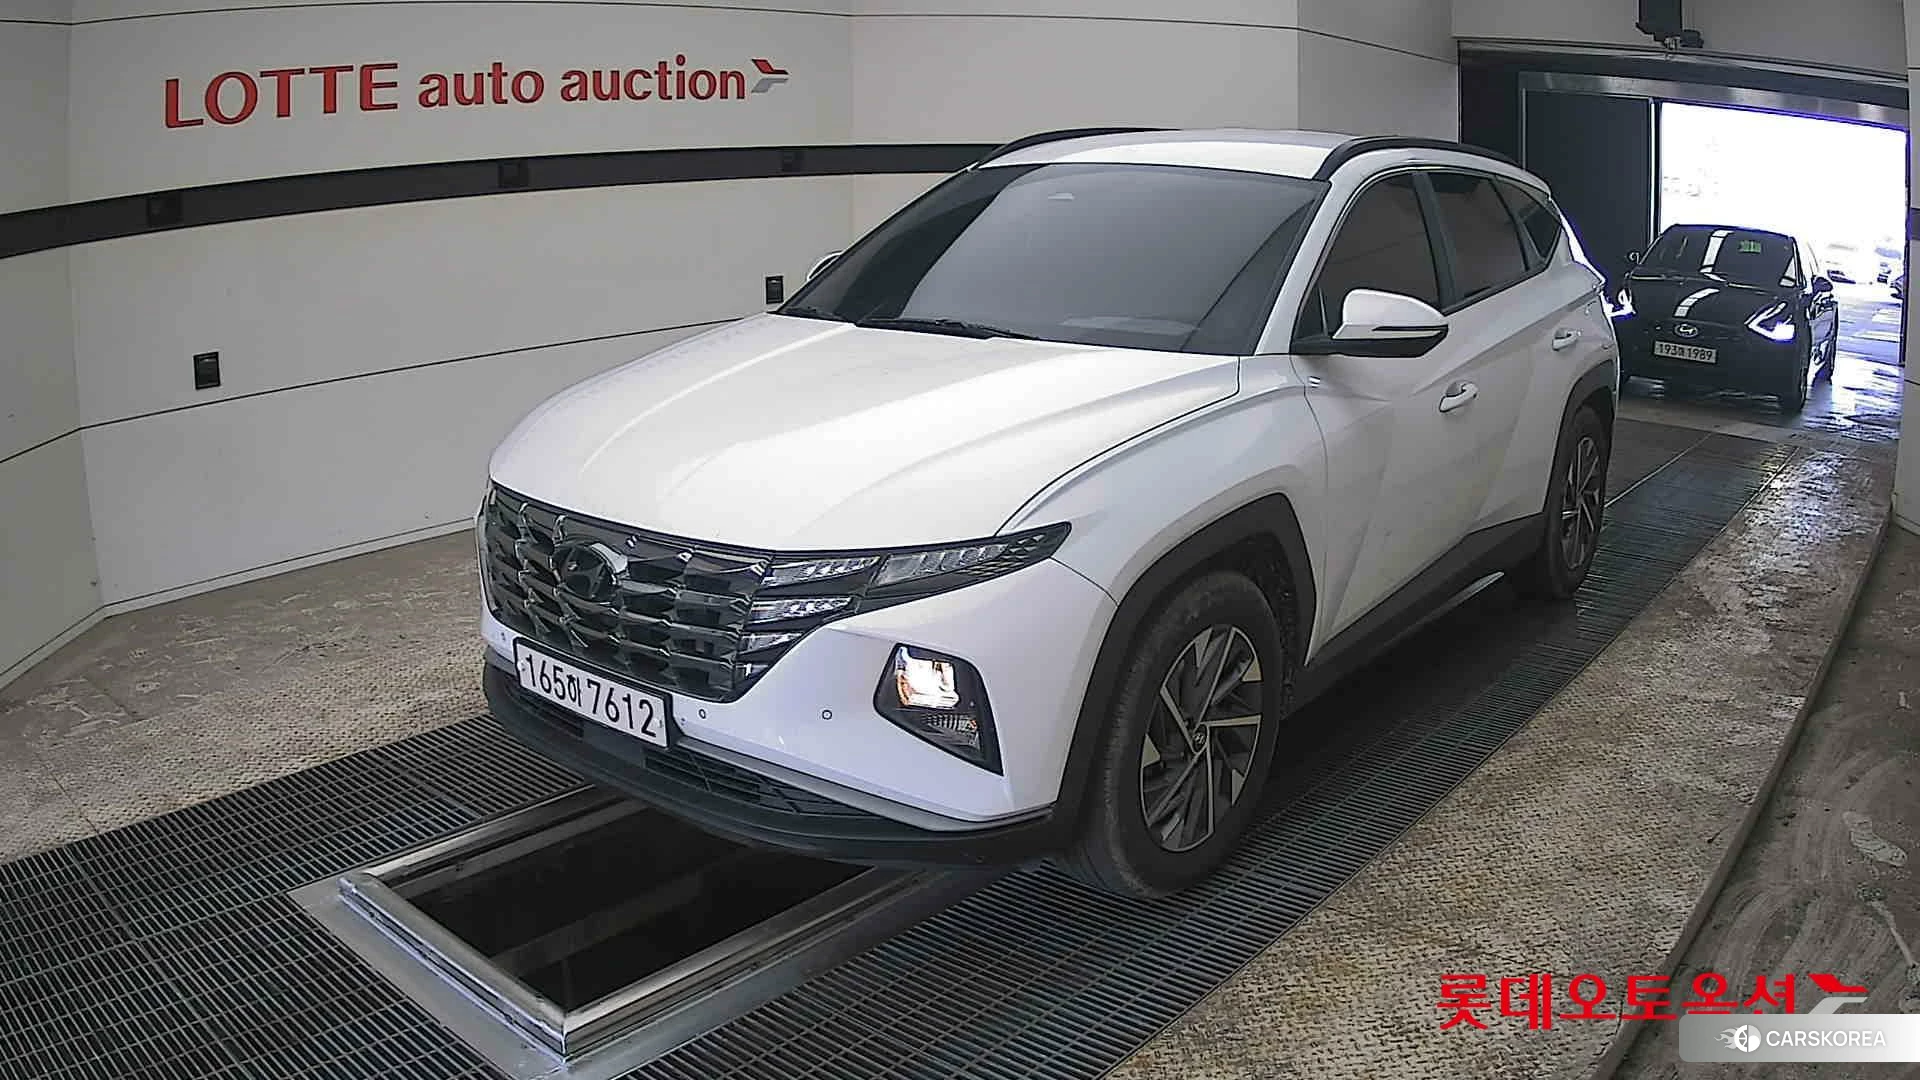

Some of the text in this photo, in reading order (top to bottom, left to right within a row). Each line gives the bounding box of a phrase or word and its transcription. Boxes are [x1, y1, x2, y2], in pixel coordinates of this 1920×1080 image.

[165, 54, 746, 128] LOTTE auto auction
